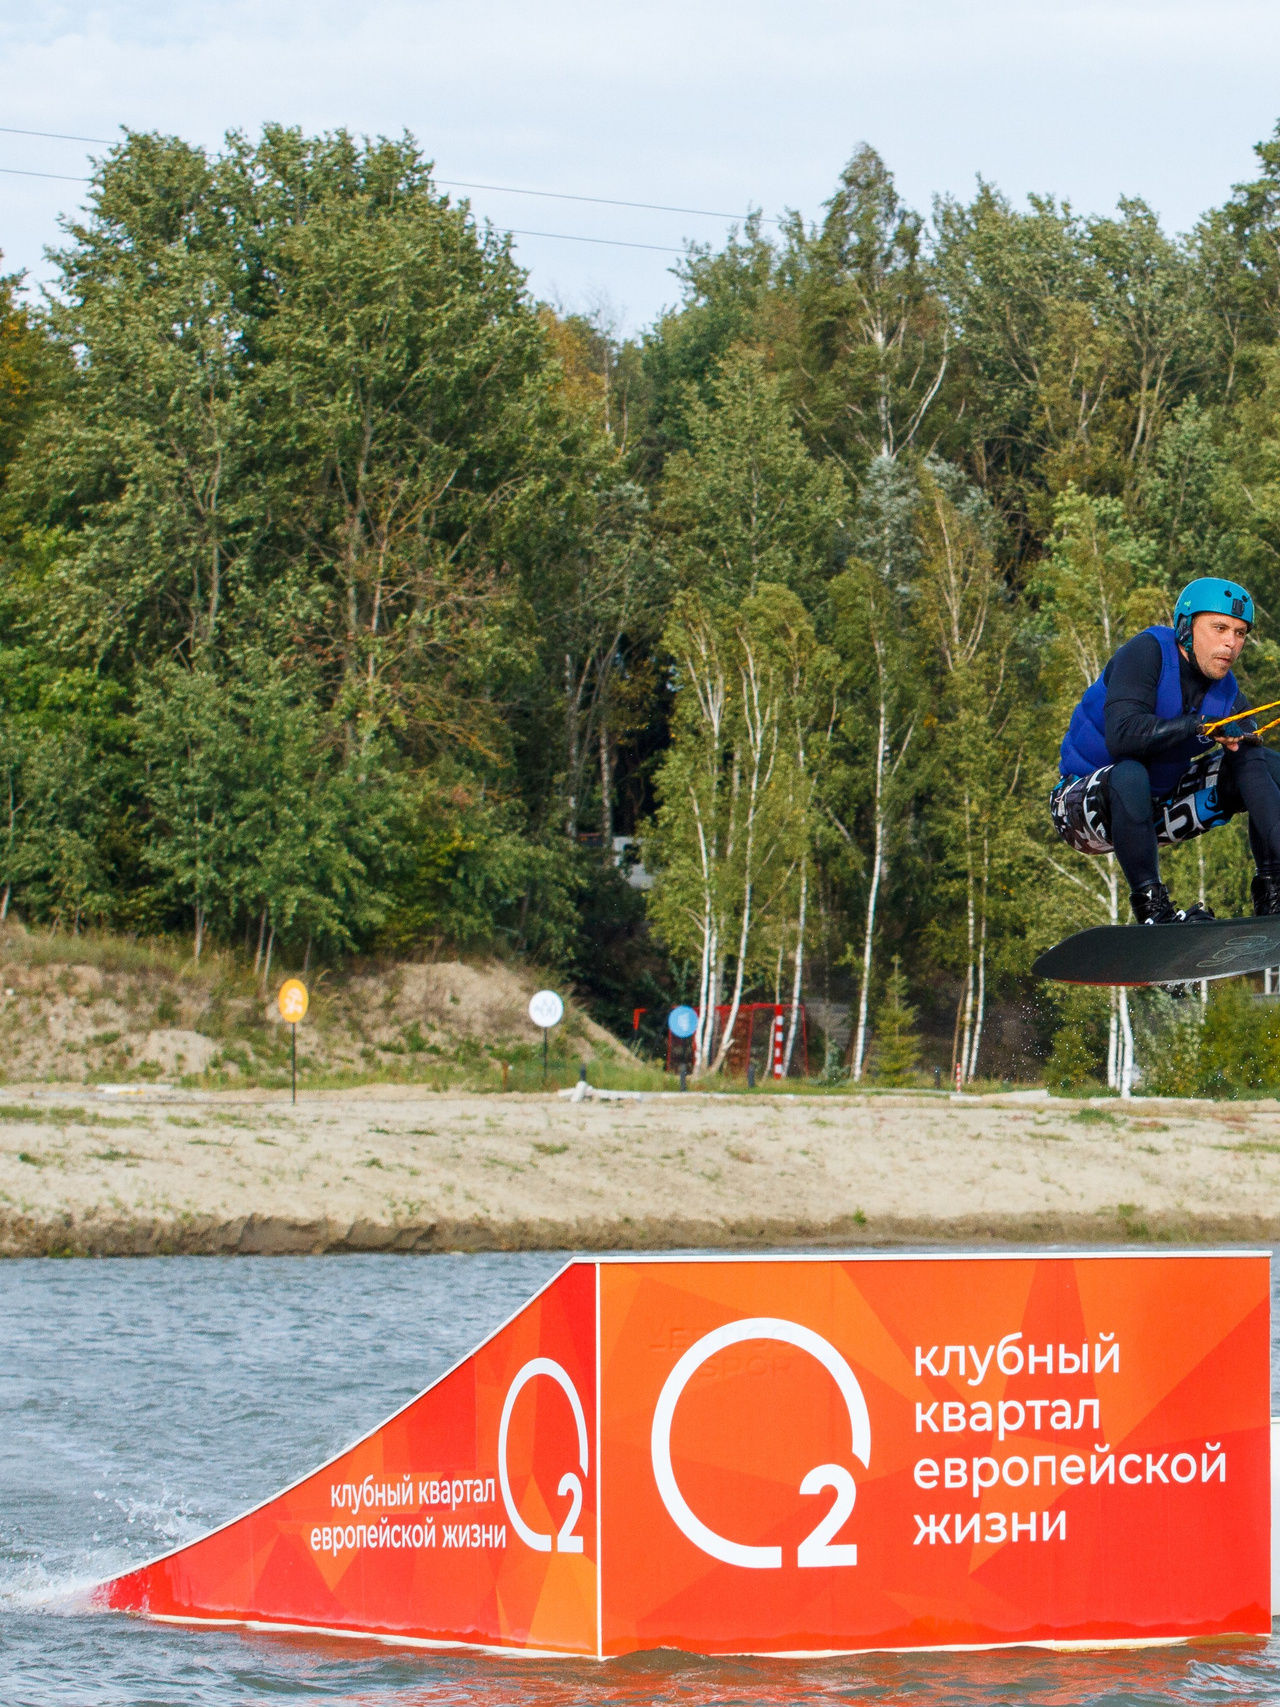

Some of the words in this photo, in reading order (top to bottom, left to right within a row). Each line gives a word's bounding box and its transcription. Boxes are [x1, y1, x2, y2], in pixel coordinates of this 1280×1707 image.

[915, 1332, 1120, 1387] клубный
[915, 1398, 1100, 1440] квартал
[913, 1441, 1226, 1498] европейской
[330, 1474, 413, 1514] клубный
[418, 1478, 496, 1511] квартал
[310, 1516, 436, 1557] европейской
[442, 1523, 507, 1549] жизни
[912, 1510, 1067, 1546] жизни
